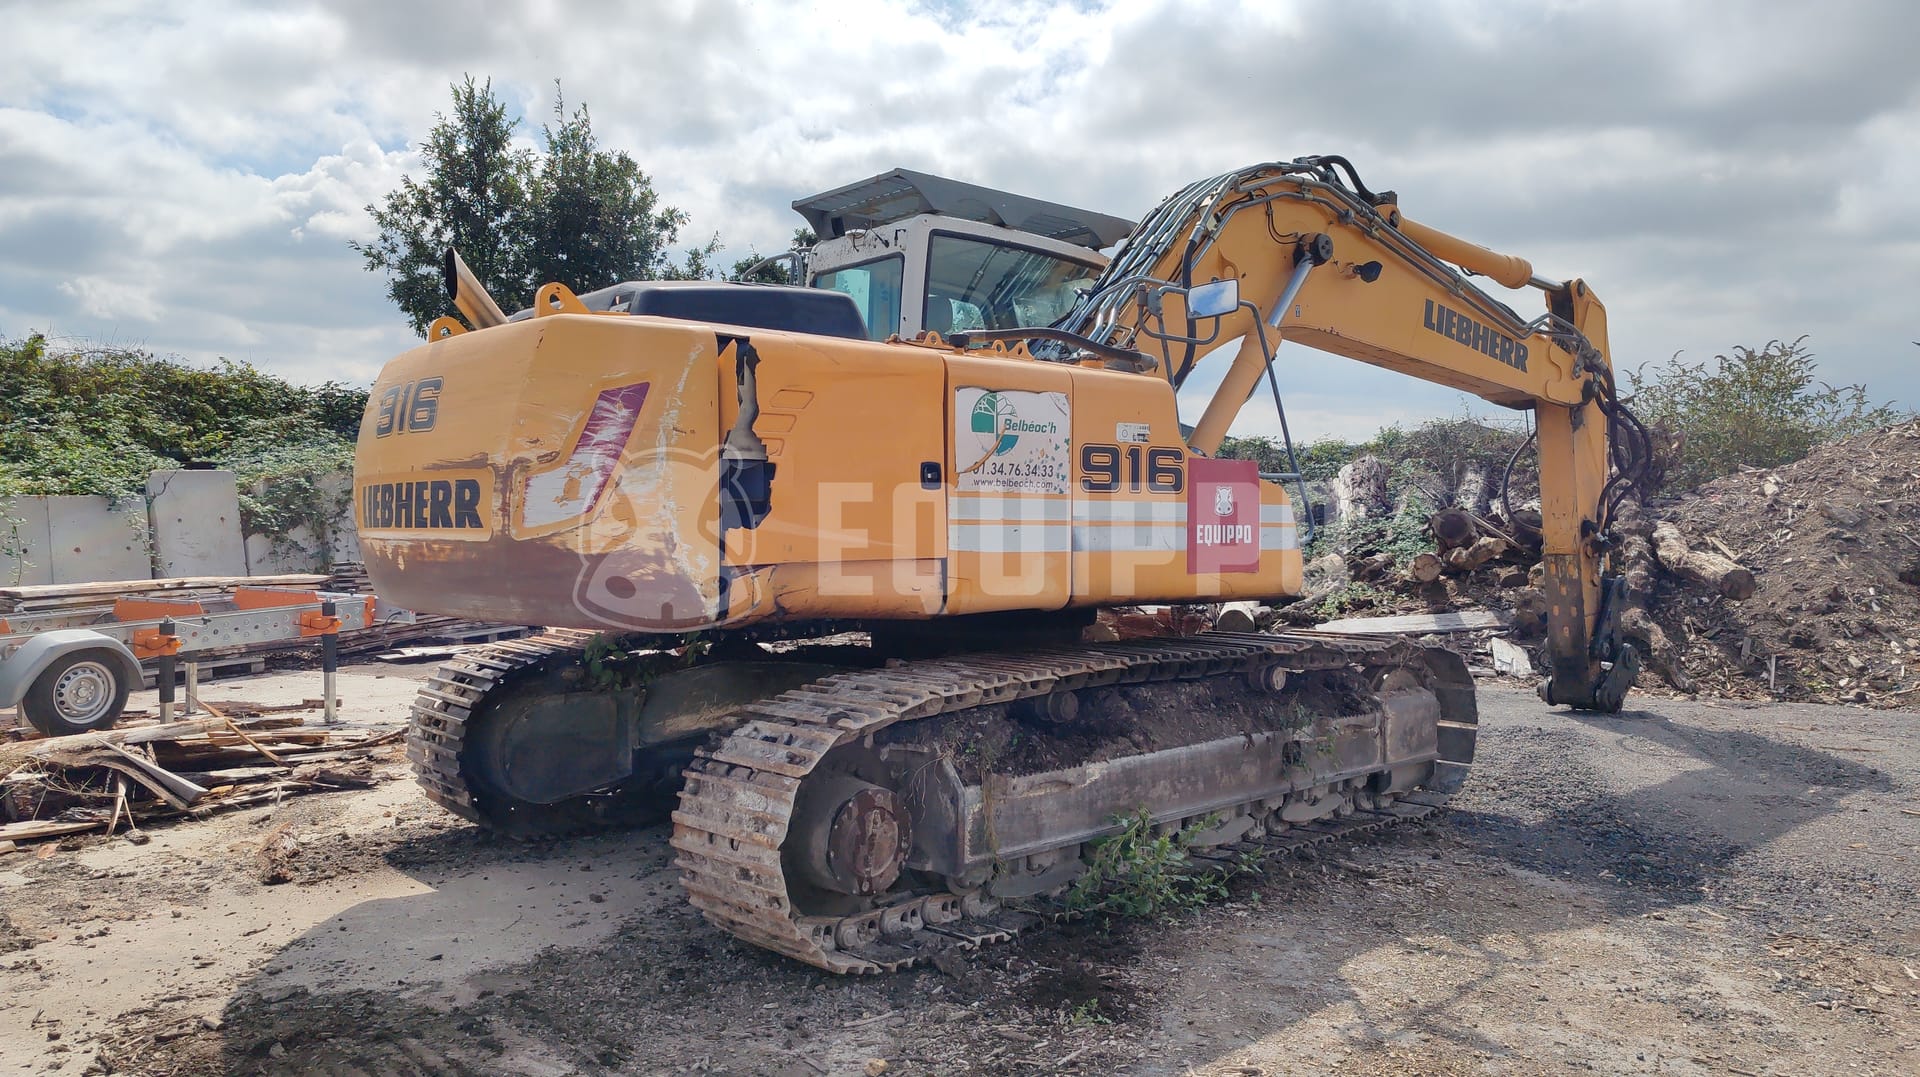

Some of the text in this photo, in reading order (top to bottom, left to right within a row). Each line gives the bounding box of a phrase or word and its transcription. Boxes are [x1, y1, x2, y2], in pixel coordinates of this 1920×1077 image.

[1423, 298, 1529, 374] LIEBHERR
[376, 376, 444, 439] 916
[1080, 443, 1184, 494] 916
[362, 479, 484, 529] LIEBHERR
[1196, 525, 1252, 546] EQUIPPO
